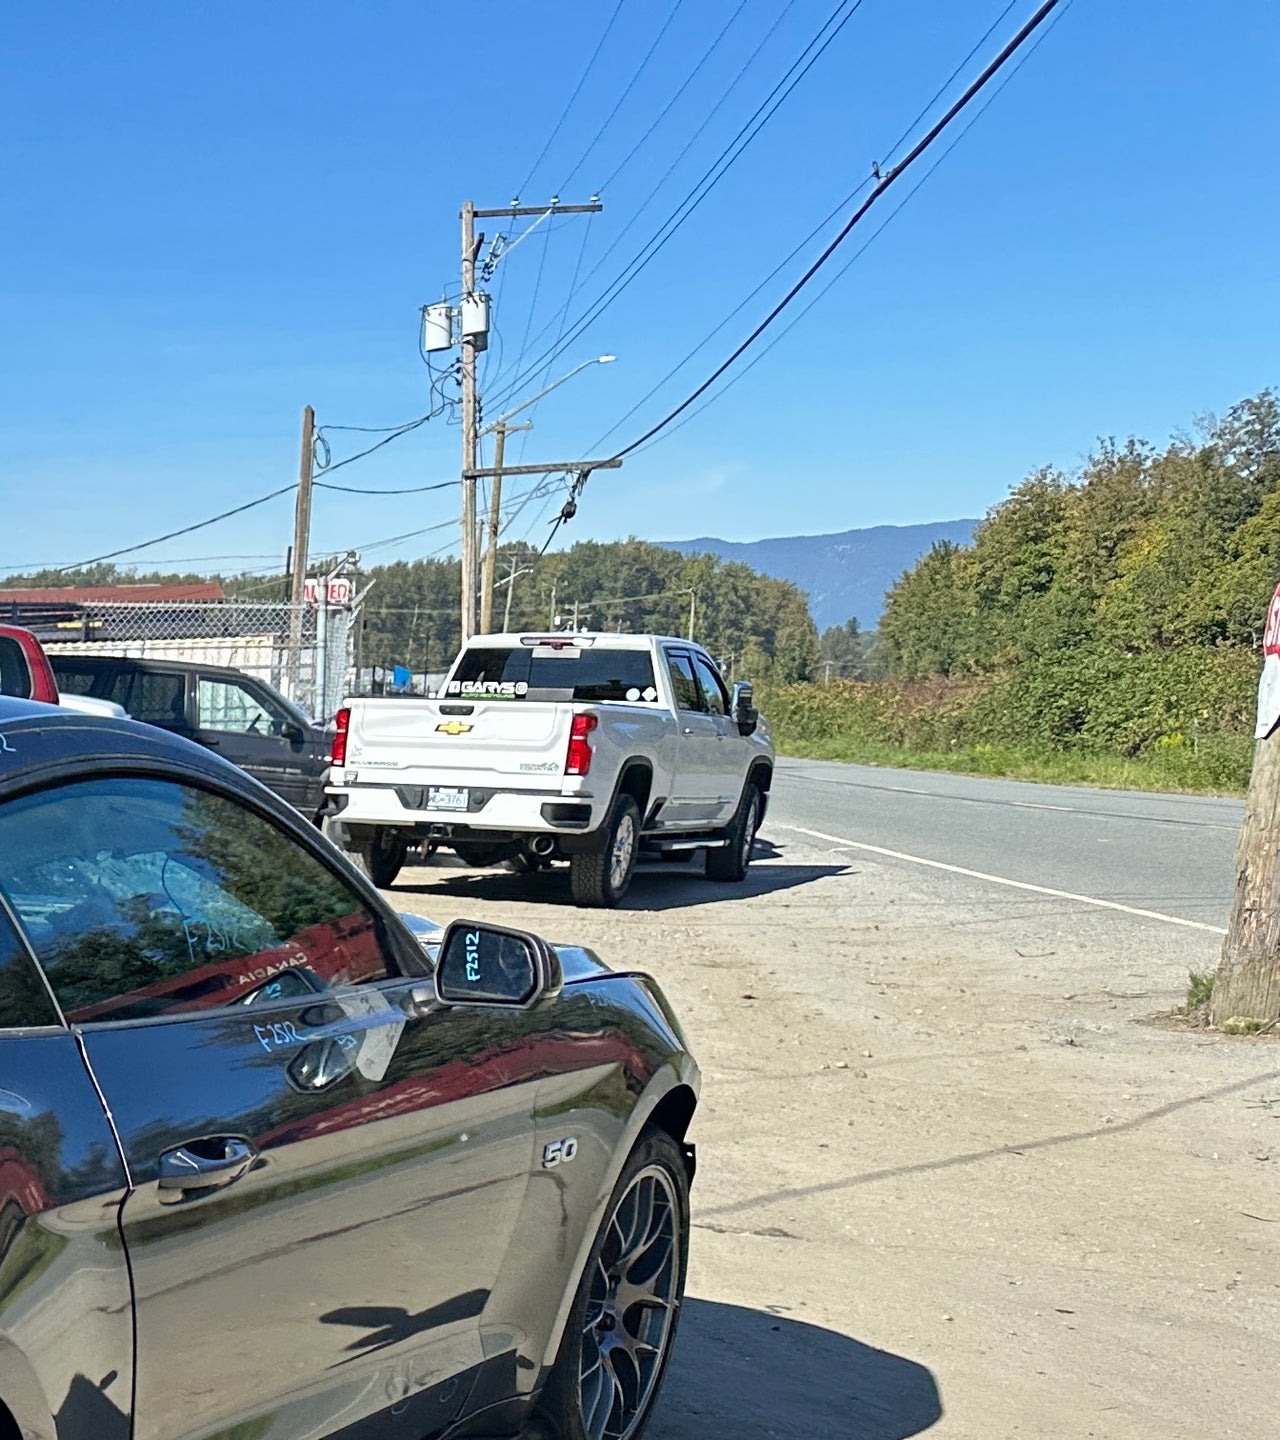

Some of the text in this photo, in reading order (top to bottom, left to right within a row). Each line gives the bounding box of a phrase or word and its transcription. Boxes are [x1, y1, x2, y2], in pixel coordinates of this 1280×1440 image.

[461, 682, 515, 694] GARYS
[465, 930, 480, 982] F2512
[253, 1020, 308, 1053] F2512
